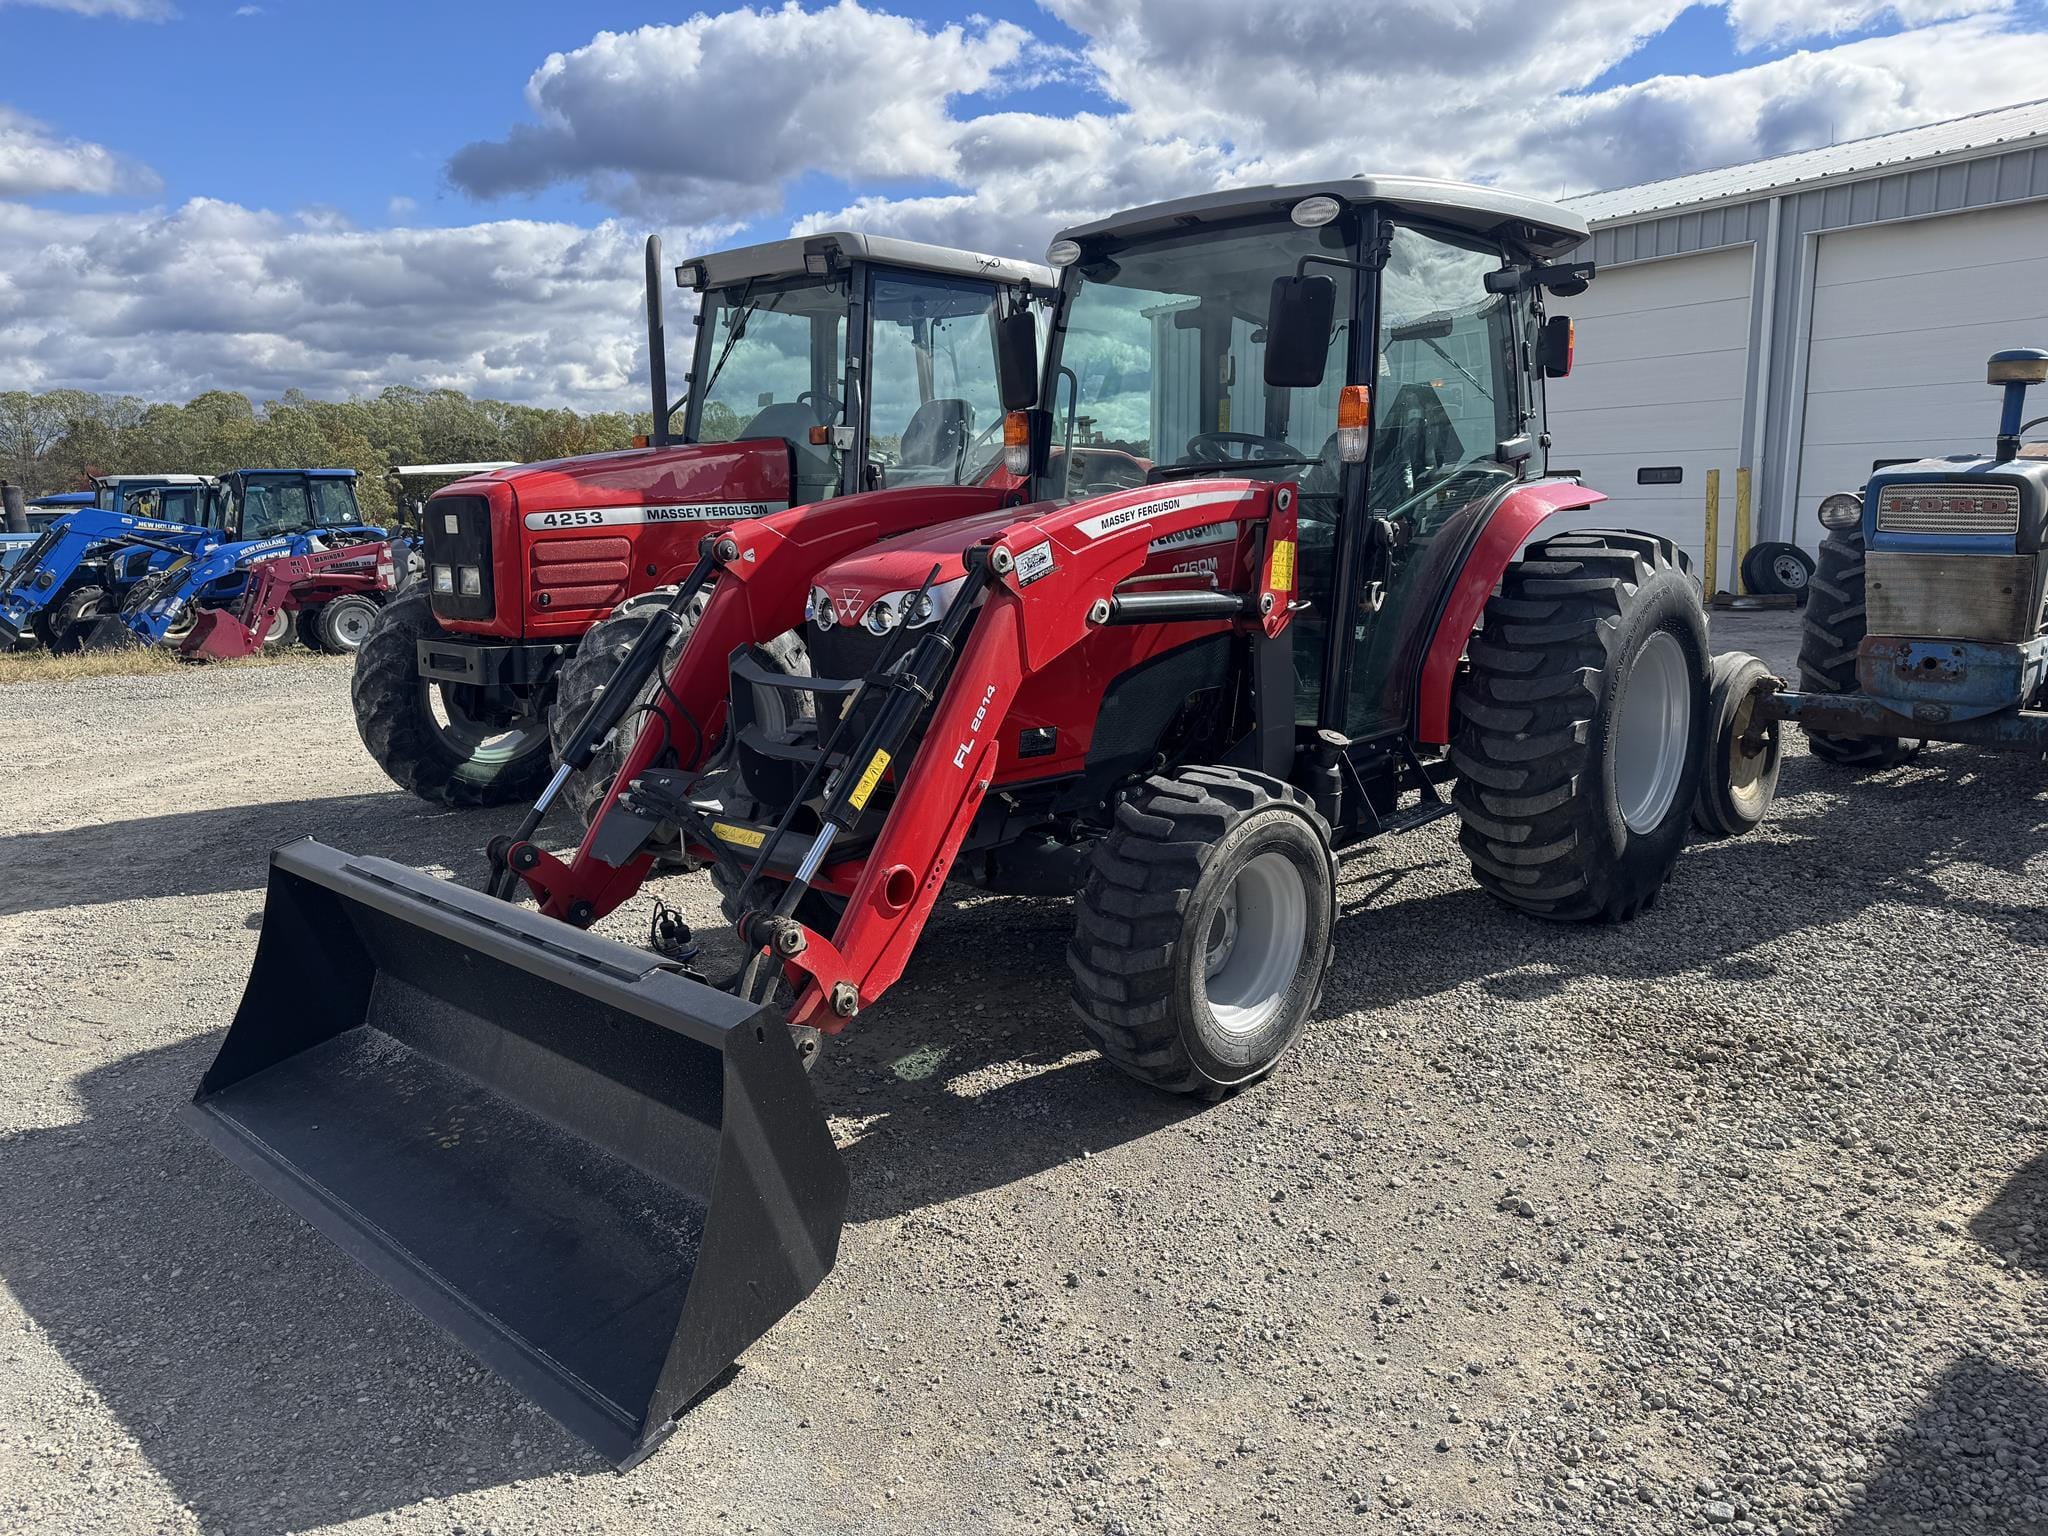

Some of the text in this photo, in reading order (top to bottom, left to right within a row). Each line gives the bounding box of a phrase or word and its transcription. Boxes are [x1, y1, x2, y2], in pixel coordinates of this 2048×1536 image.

[1101, 498, 1180, 530] MASSEY FERGUSON
[1890, 499, 2008, 514] FORD
[543, 504, 769, 527] 4253 MASSEY FERGUSON
[138, 521, 154, 529] NEW
[240, 538, 287, 556] NEW HOLLAND
[253, 554, 268, 564] NEW
[314, 552, 345, 563] MAHINDRA
[331, 561, 360, 569] MAHINDRA
[952, 684, 997, 769] FL 2814
[1225, 811, 1288, 851] GALAXY
